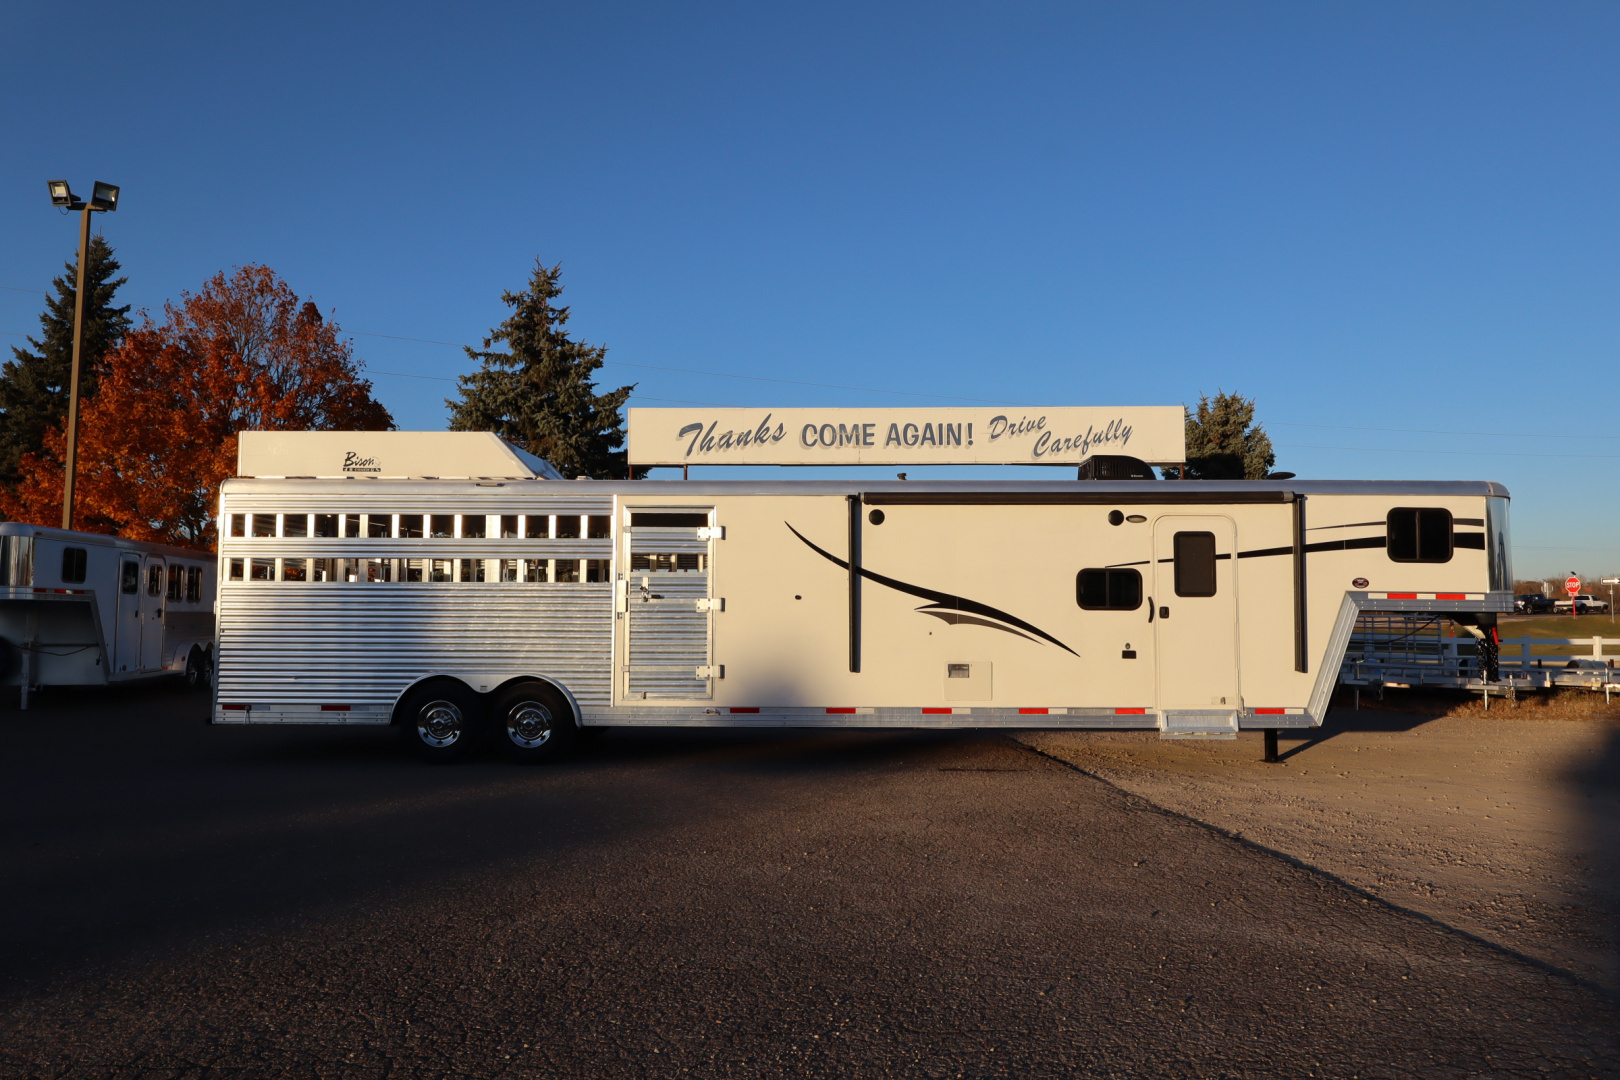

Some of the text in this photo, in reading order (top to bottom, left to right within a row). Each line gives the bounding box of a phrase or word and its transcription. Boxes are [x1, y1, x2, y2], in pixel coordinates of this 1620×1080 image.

[679, 413, 973, 456] Thanks COME AGAIN!
[989, 415, 1046, 440] Drive
[1033, 418, 1133, 457] Carefully
[343, 451, 374, 467] Bison
